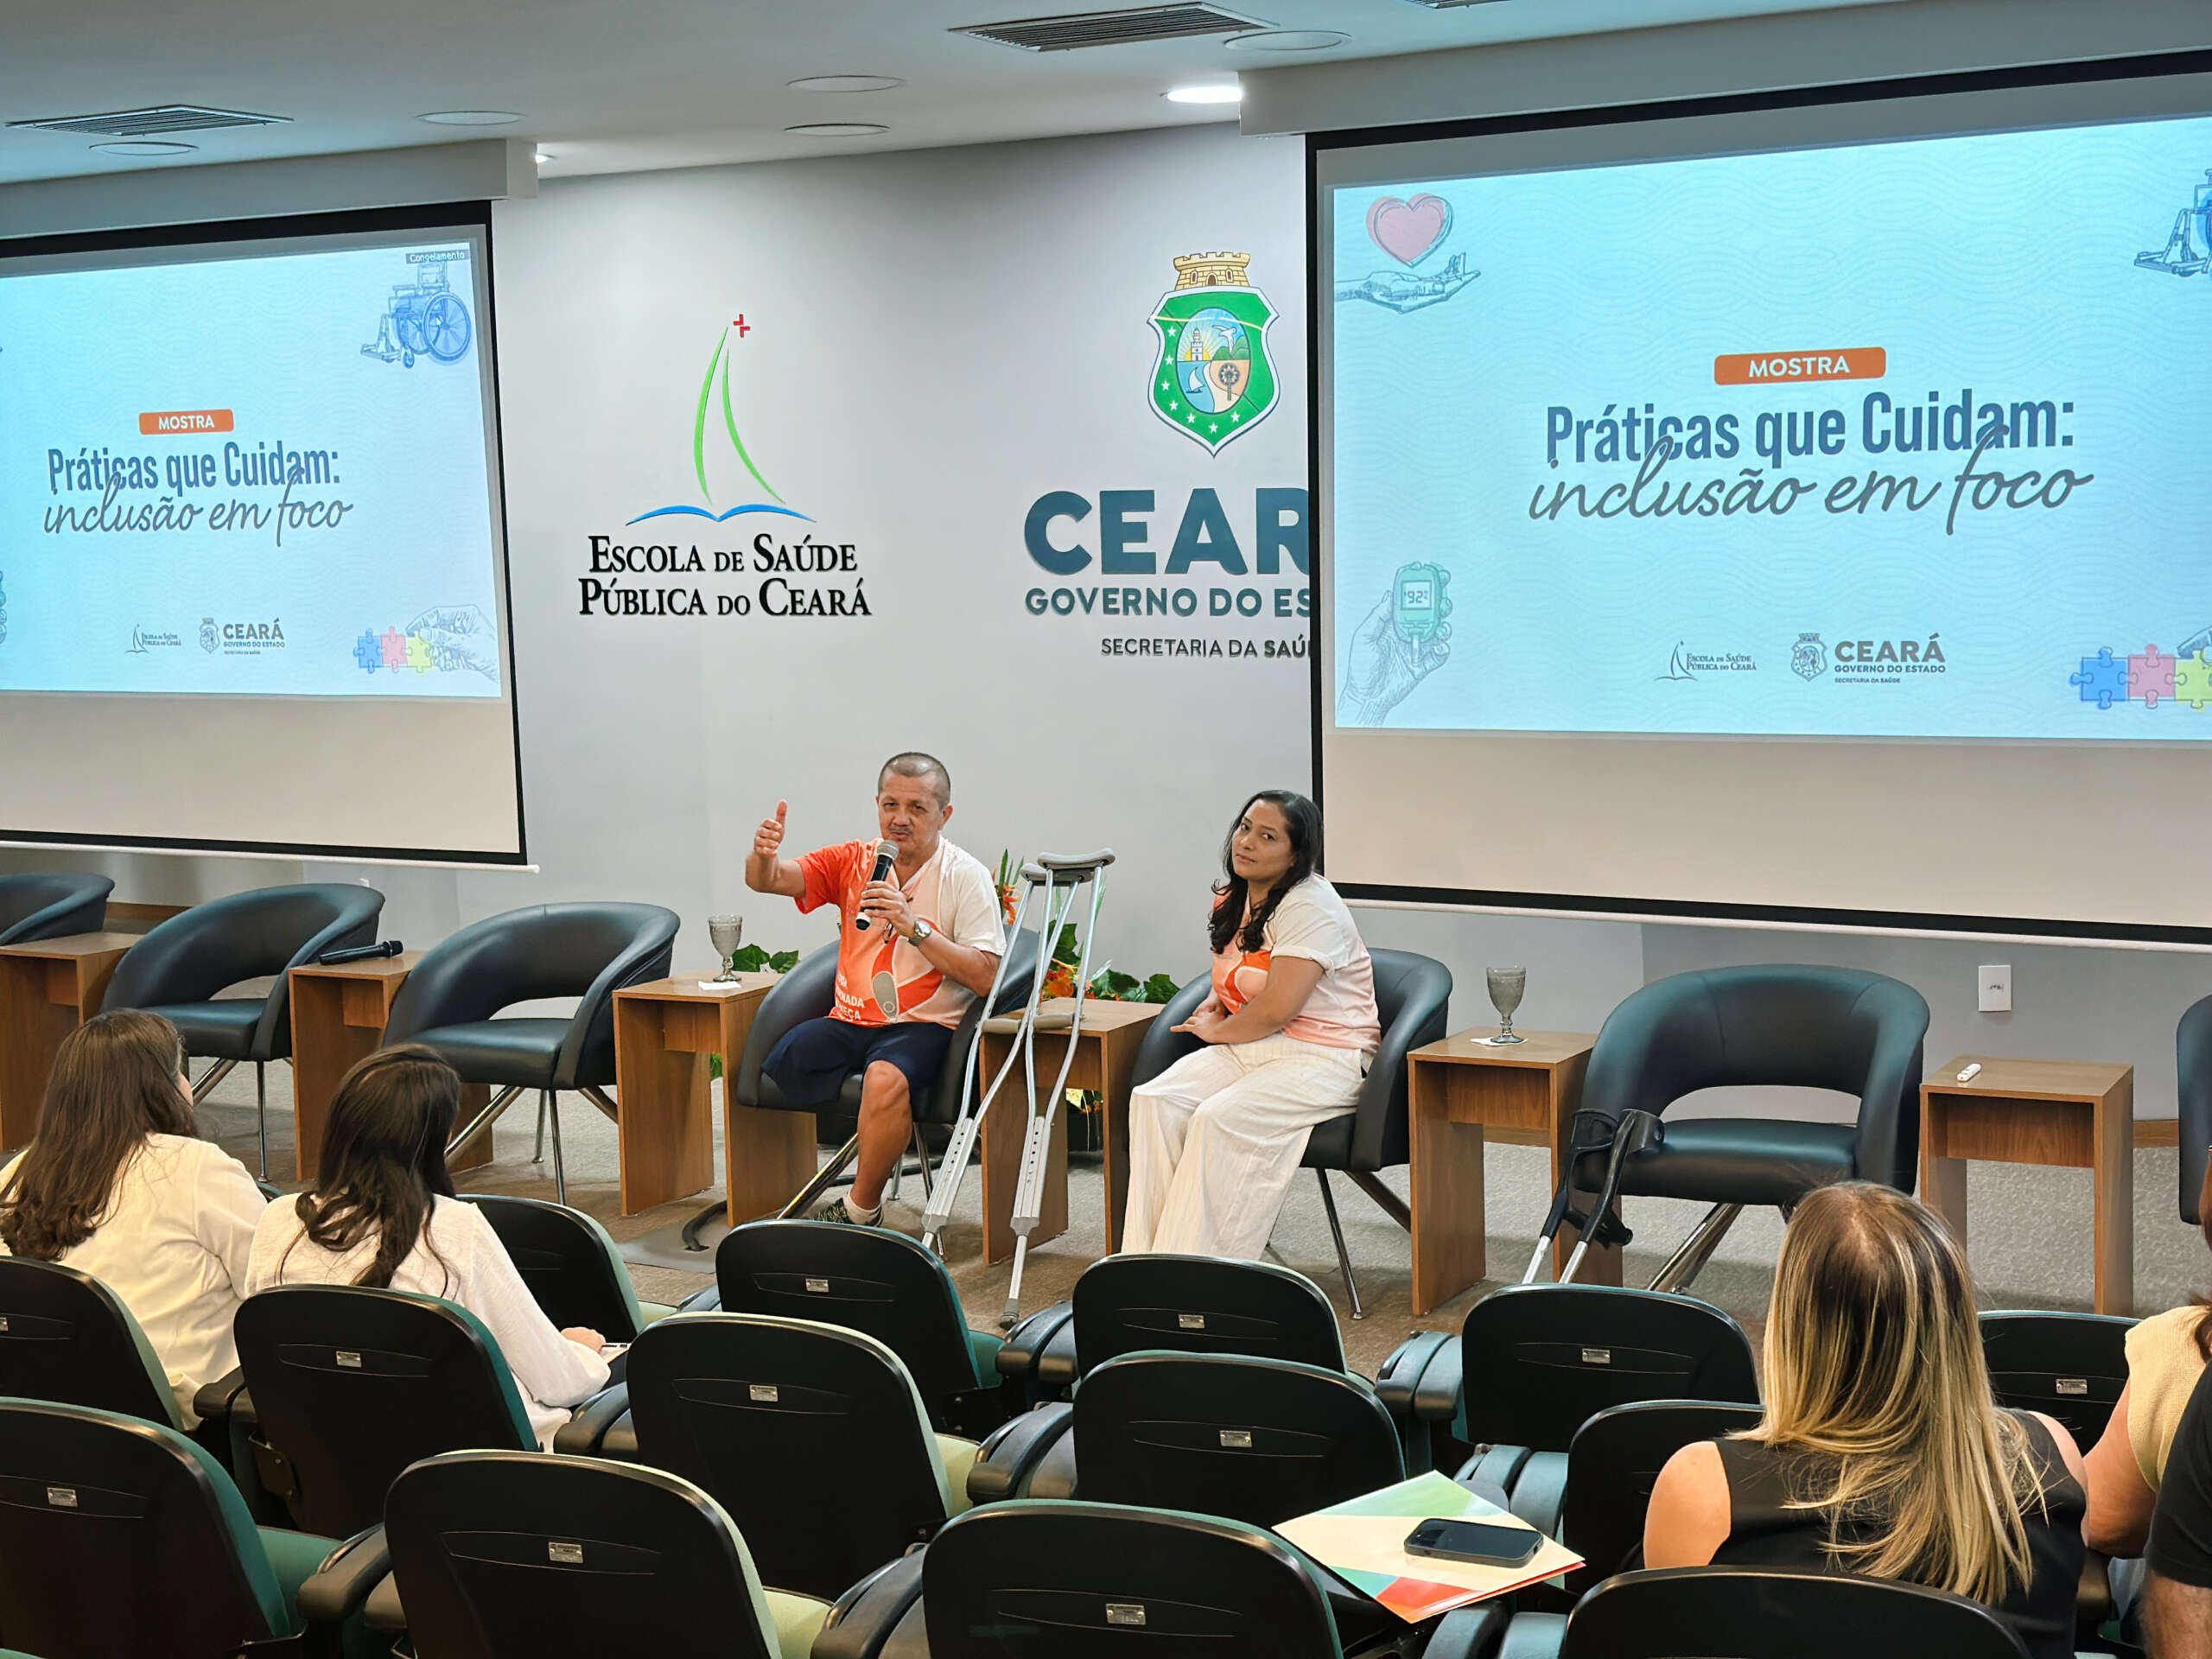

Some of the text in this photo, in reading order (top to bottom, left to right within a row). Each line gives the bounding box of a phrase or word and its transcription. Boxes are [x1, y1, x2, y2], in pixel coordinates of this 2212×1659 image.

[410, 251, 465, 262] Congelamento
[1749, 356, 1851, 378] MOSTRA
[158, 415, 215, 430] MOSTRA
[1547, 388, 2075, 469] Práticas que Cuidam:
[48, 440, 340, 497] Práticas que Cuidam:
[1529, 425, 2094, 537] inclusão em foco
[44, 467, 354, 548] inclusão em foco
[588, 535, 705, 573] ESCOLA
[753, 533, 858, 571] SAÚDE
[578, 577, 708, 616] PÚBLICA
[759, 577, 872, 616] CEARÁ
[1026, 587, 1198, 617] GOVERNO
[1209, 588, 1262, 617] DO
[223, 618, 284, 639] CEARÁ
[1101, 633, 1311, 658] SECRETARIA DA SAÚ
[1834, 632, 1946, 663] CEARÁ
[1834, 664, 1946, 673] GOVERNO DO ESTADO
